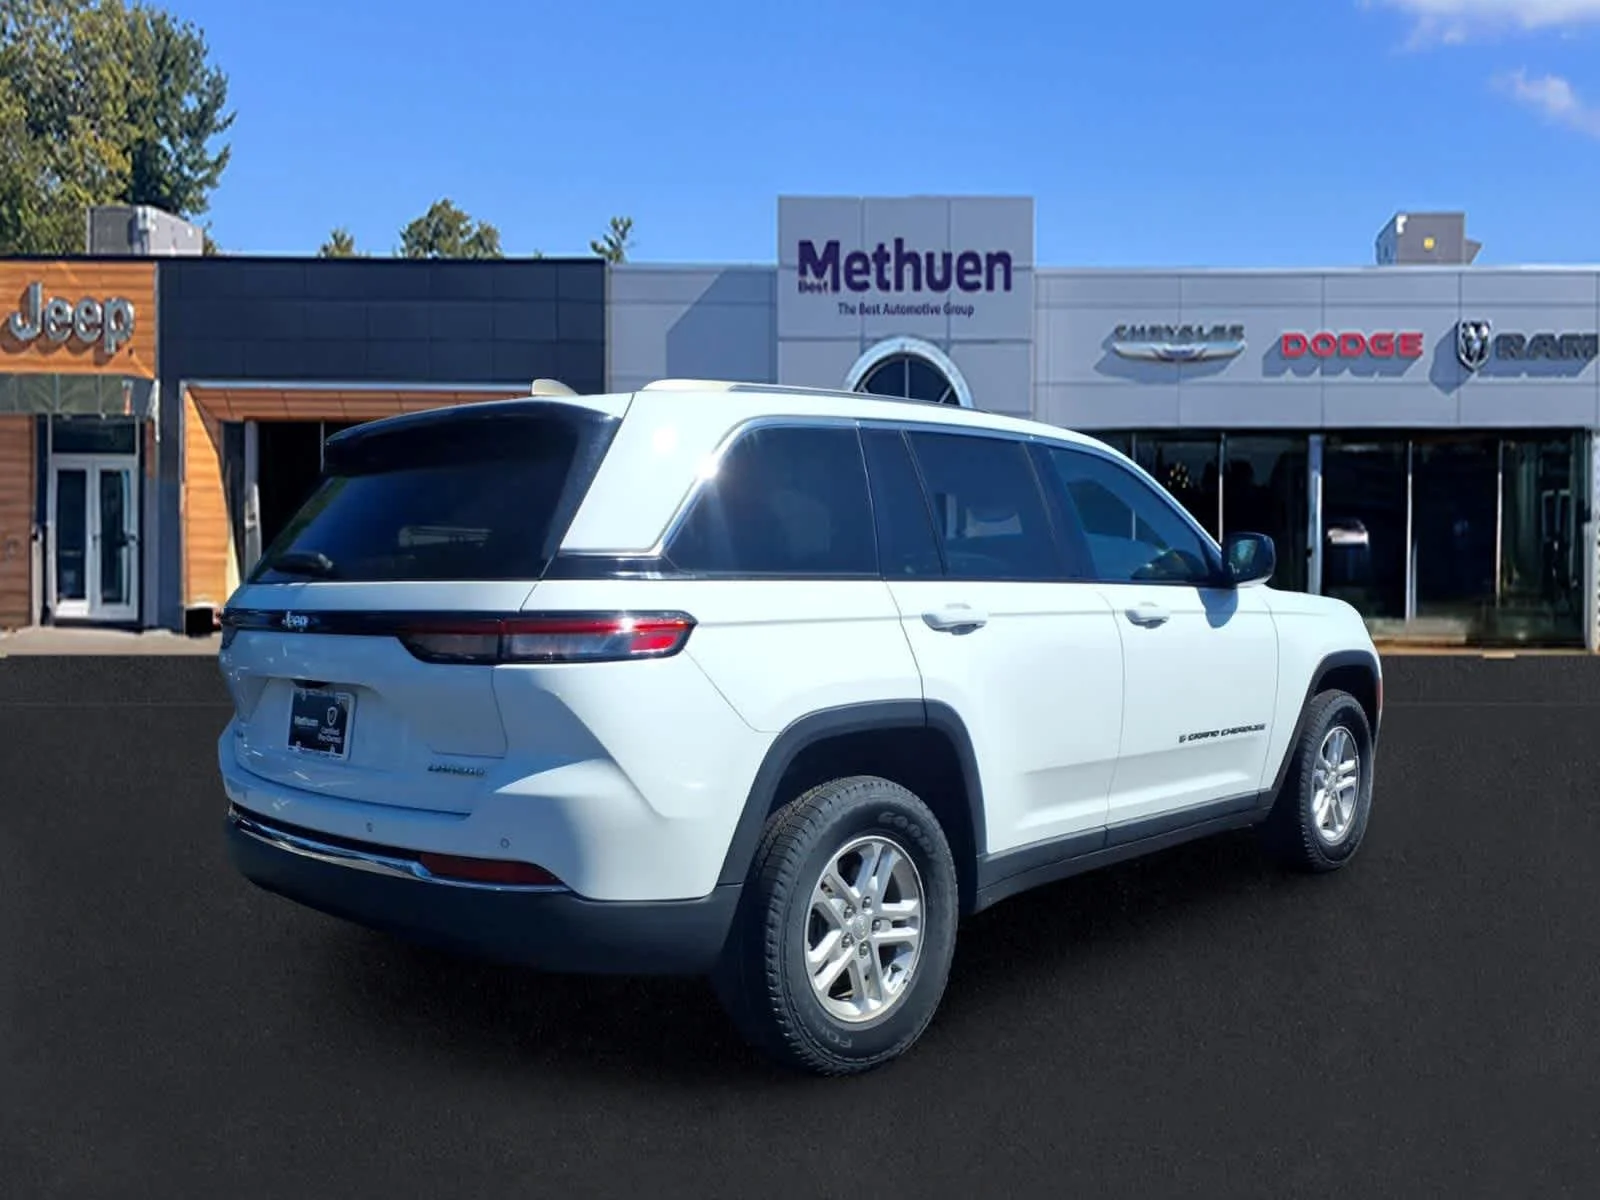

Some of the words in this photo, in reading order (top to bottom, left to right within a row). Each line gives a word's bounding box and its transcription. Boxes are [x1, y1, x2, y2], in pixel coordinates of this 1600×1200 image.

[798, 237, 1012, 293] Methuen
[9, 280, 136, 354] Jeep
[838, 302, 857, 315] The
[859, 302, 881, 315] Best
[883, 302, 942, 315] Automotive
[943, 302, 975, 317] Group
[1280, 332, 1424, 358] DODGE
[1495, 333, 1600, 360] RAM
